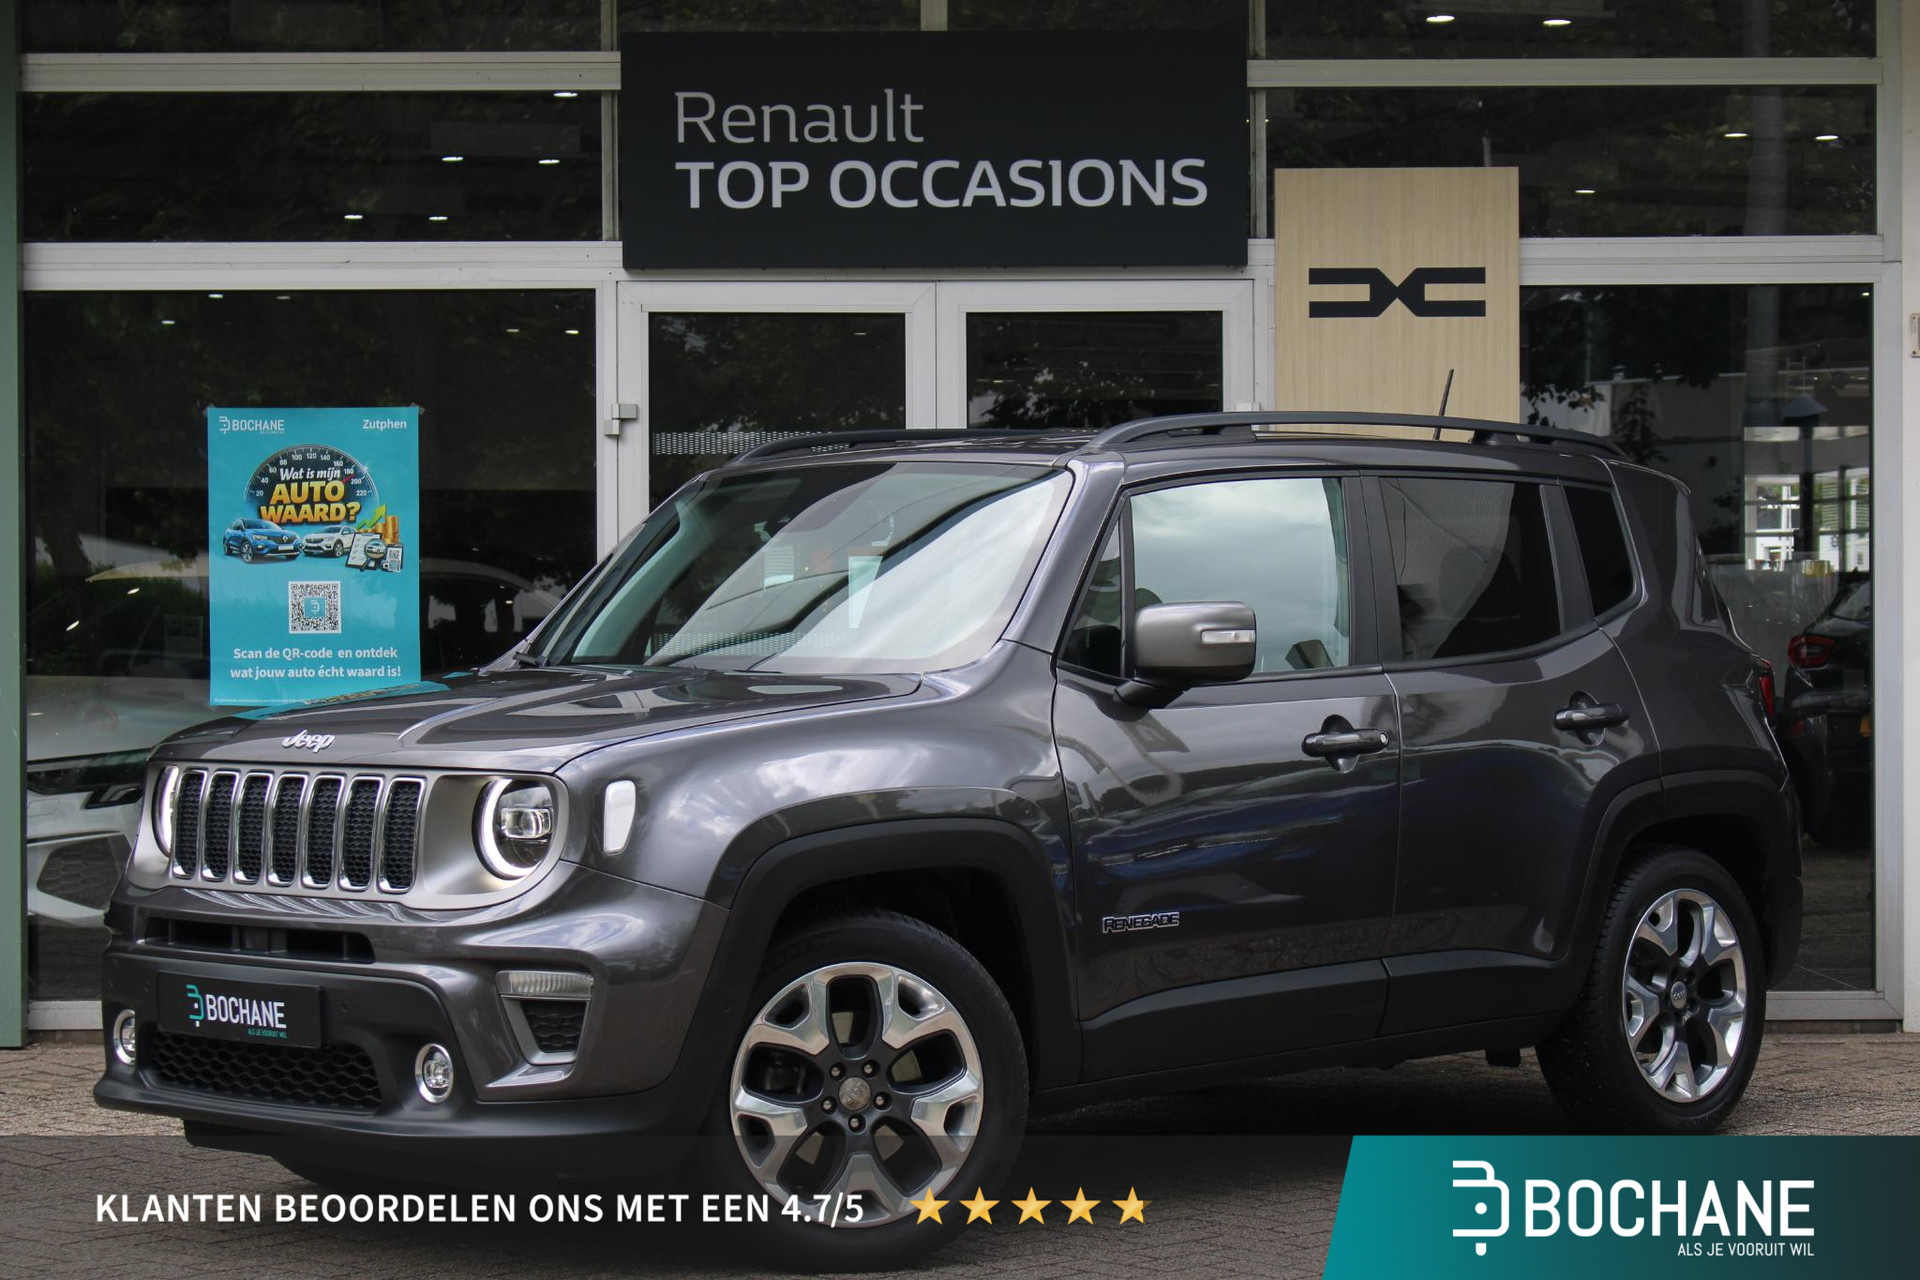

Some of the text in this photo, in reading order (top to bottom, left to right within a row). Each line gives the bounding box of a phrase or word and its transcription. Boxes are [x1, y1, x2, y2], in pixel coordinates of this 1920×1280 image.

[674, 88, 925, 144] Renault
[675, 158, 1208, 209] TOP OCCASIONS
[232, 419, 285, 431] BOCHANE
[362, 418, 407, 431] Zutphen
[256, 489, 264, 497] 20
[306, 452, 317, 460] 120
[355, 489, 367, 497] 220
[280, 466, 341, 482] Wat is mijn
[269, 480, 345, 505] AUTO
[260, 501, 361, 524] WAARD?
[233, 646, 398, 661] Scan de QR-code en ontdek
[230, 664, 401, 680] wat jouw auto écht waard is!
[281, 729, 336, 753] Jeep
[1102, 911, 1180, 933] RENEGADE
[205, 993, 287, 1029] BOCHANE
